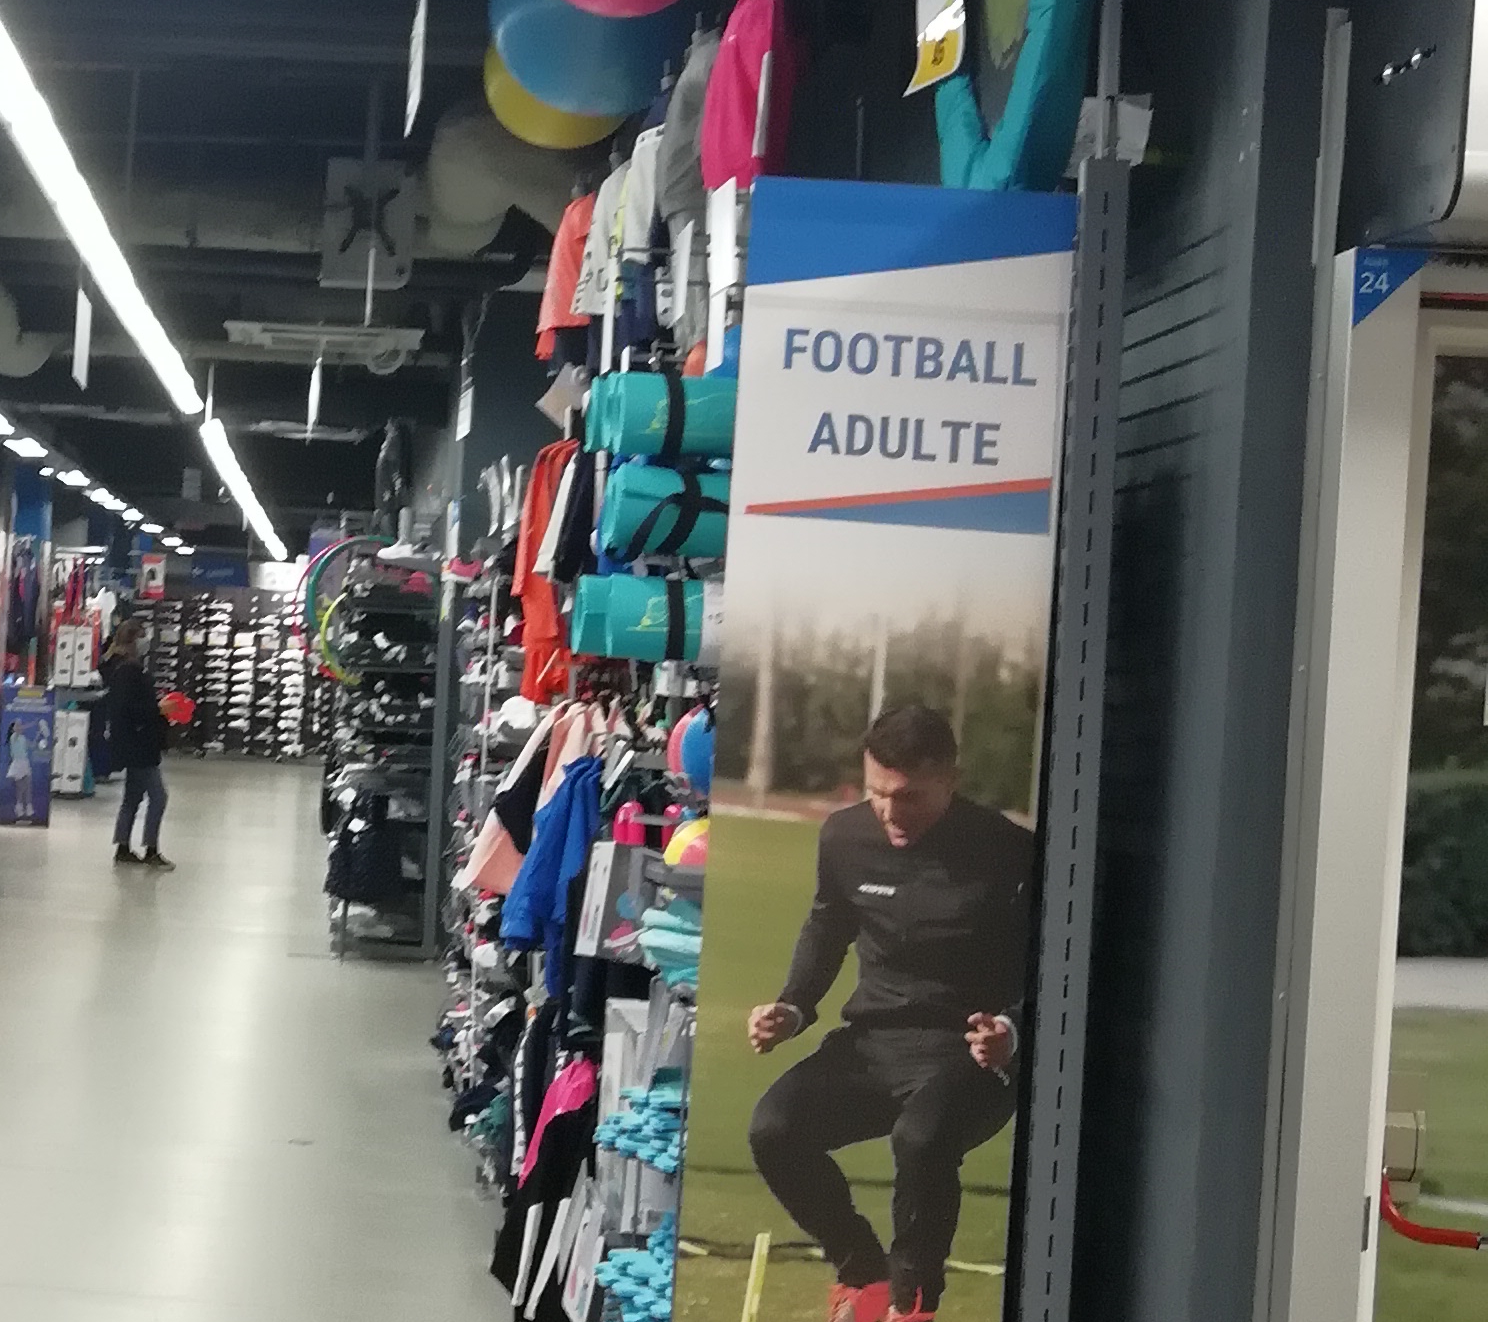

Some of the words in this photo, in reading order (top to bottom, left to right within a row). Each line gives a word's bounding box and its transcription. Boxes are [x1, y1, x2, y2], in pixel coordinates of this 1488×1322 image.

[1358, 272, 1391, 294] 24
[782, 327, 1038, 387] FOOTBALL
[806, 411, 1002, 467] ADULTE
